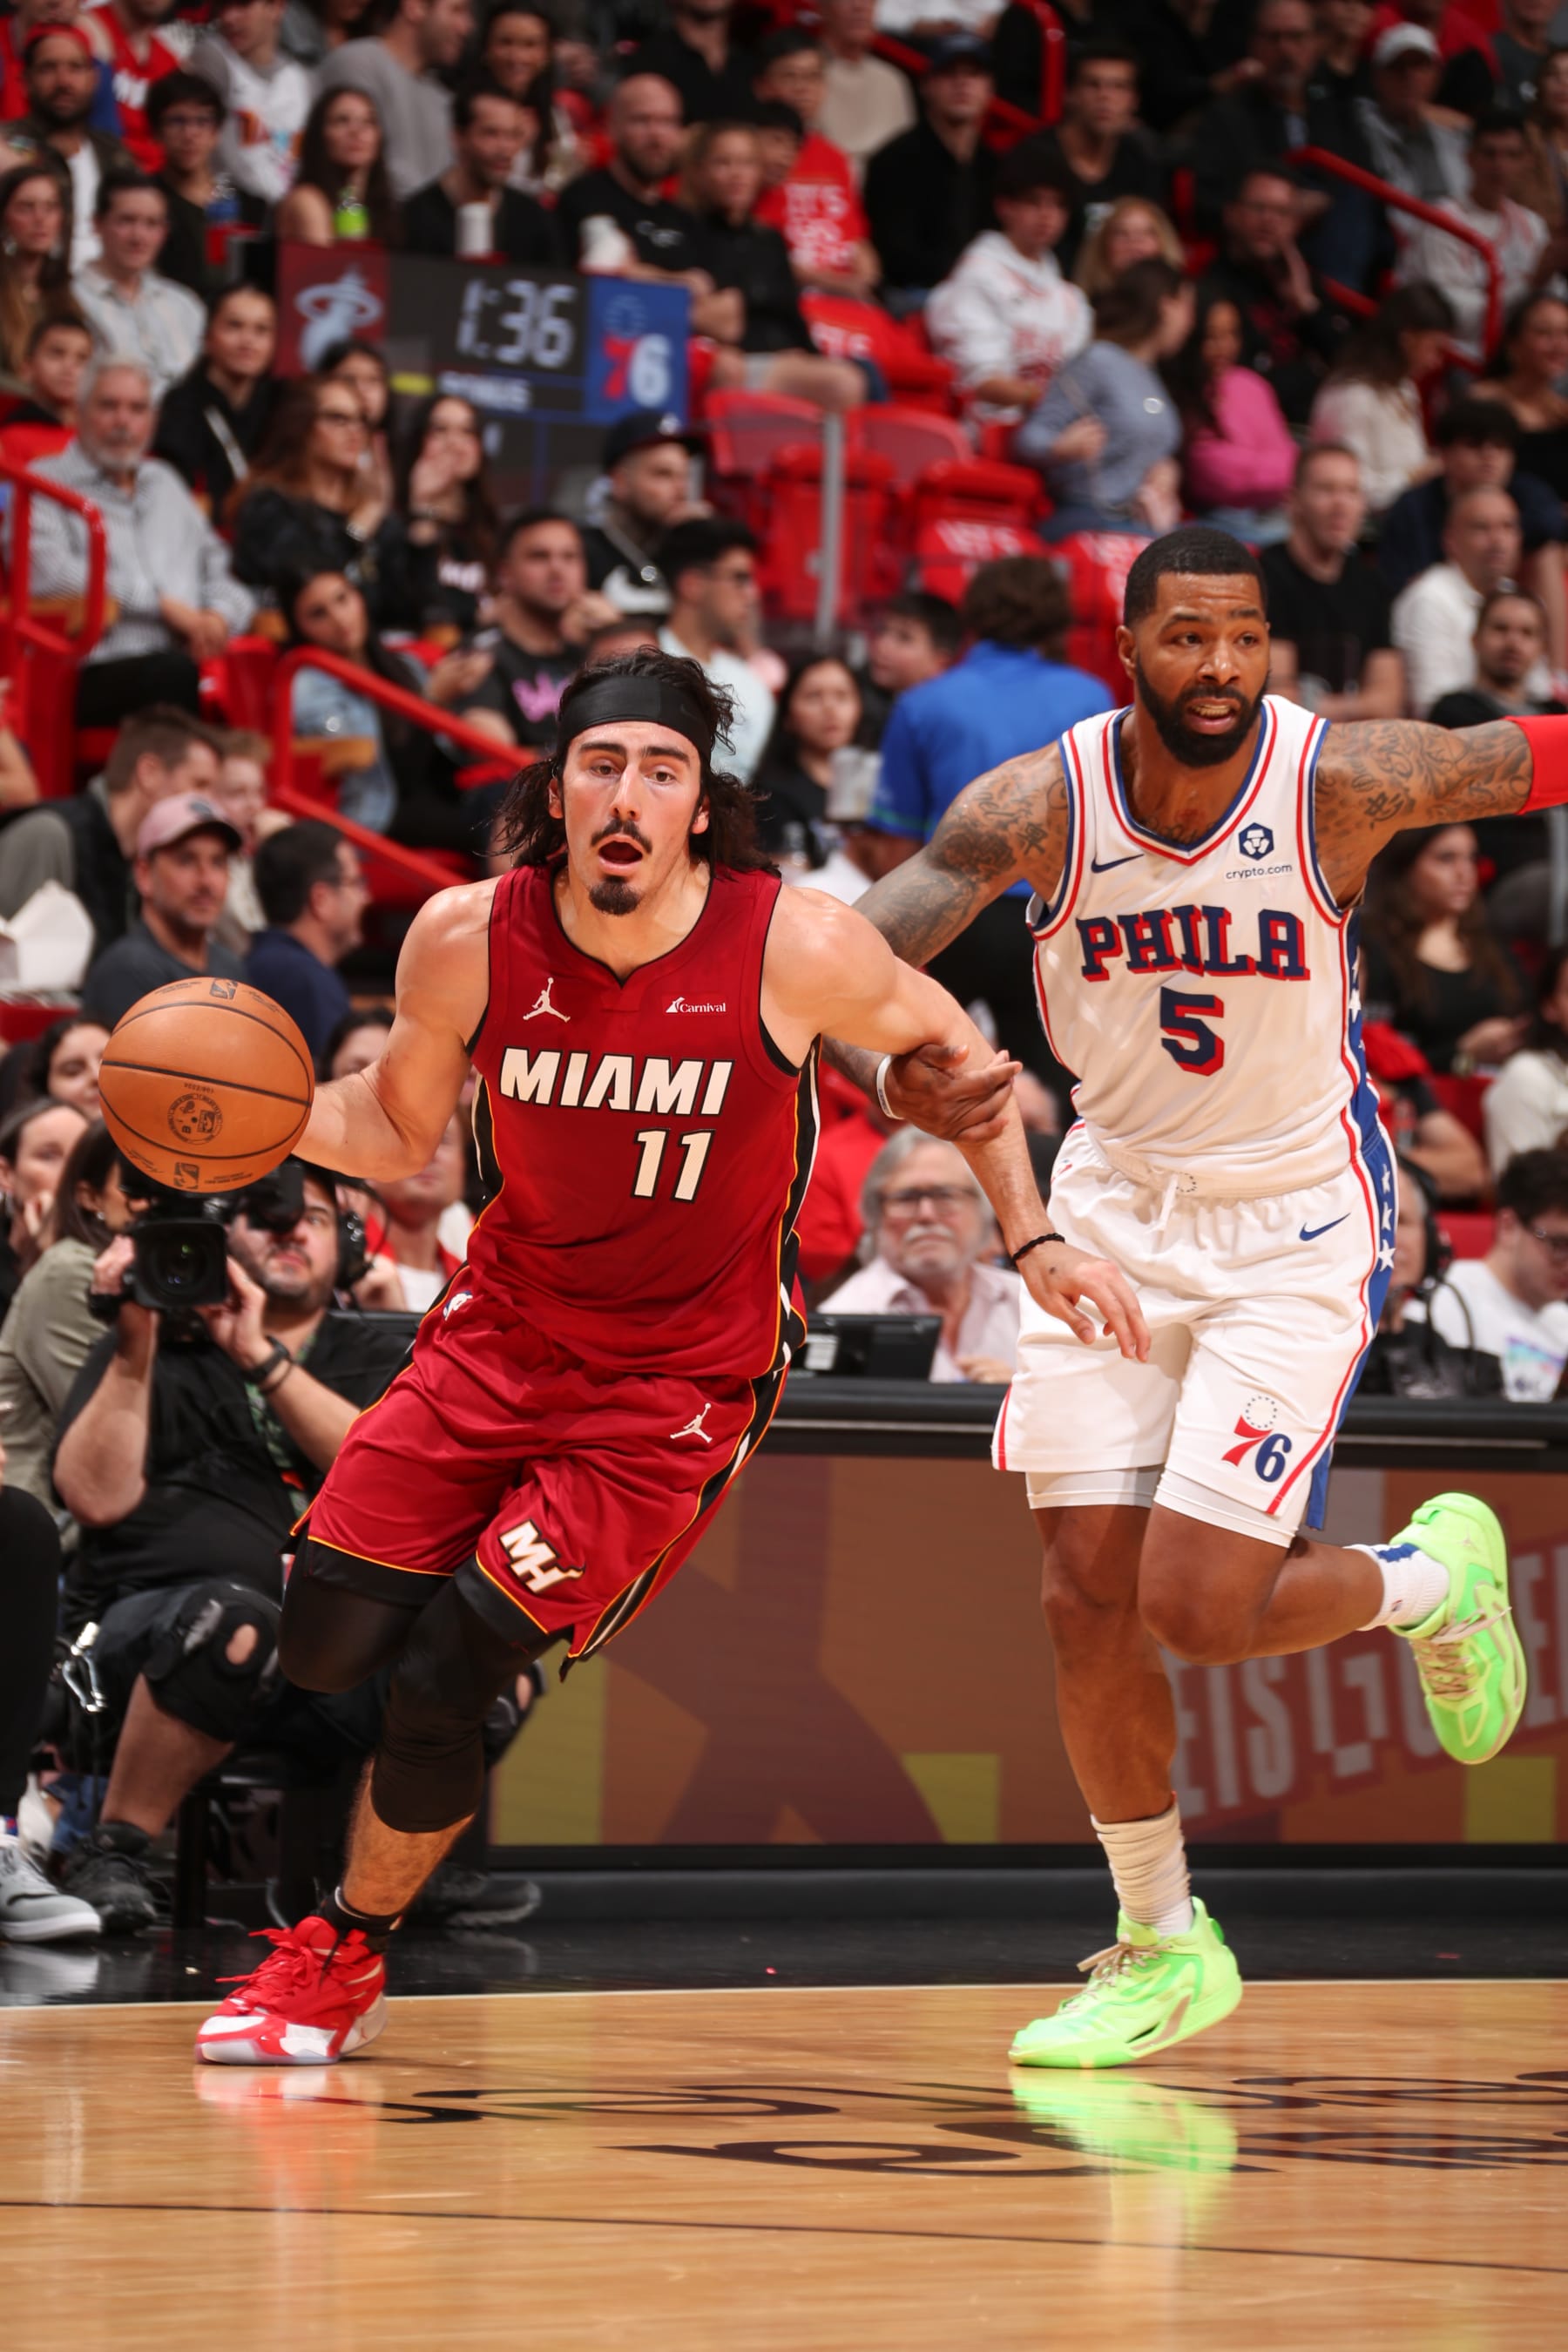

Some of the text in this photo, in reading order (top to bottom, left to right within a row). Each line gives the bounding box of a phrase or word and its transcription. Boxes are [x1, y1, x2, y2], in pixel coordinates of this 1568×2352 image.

[604, 333, 671, 408] 76
[1225, 863, 1293, 881] crypto.com
[1075, 904, 1311, 983] PHILA
[679, 1002, 727, 1014] Carnival
[1159, 986, 1225, 1077] 5
[499, 1045, 735, 1116] MIAMI
[630, 1127, 716, 1203] 11
[1220, 1414, 1293, 1483] 76
